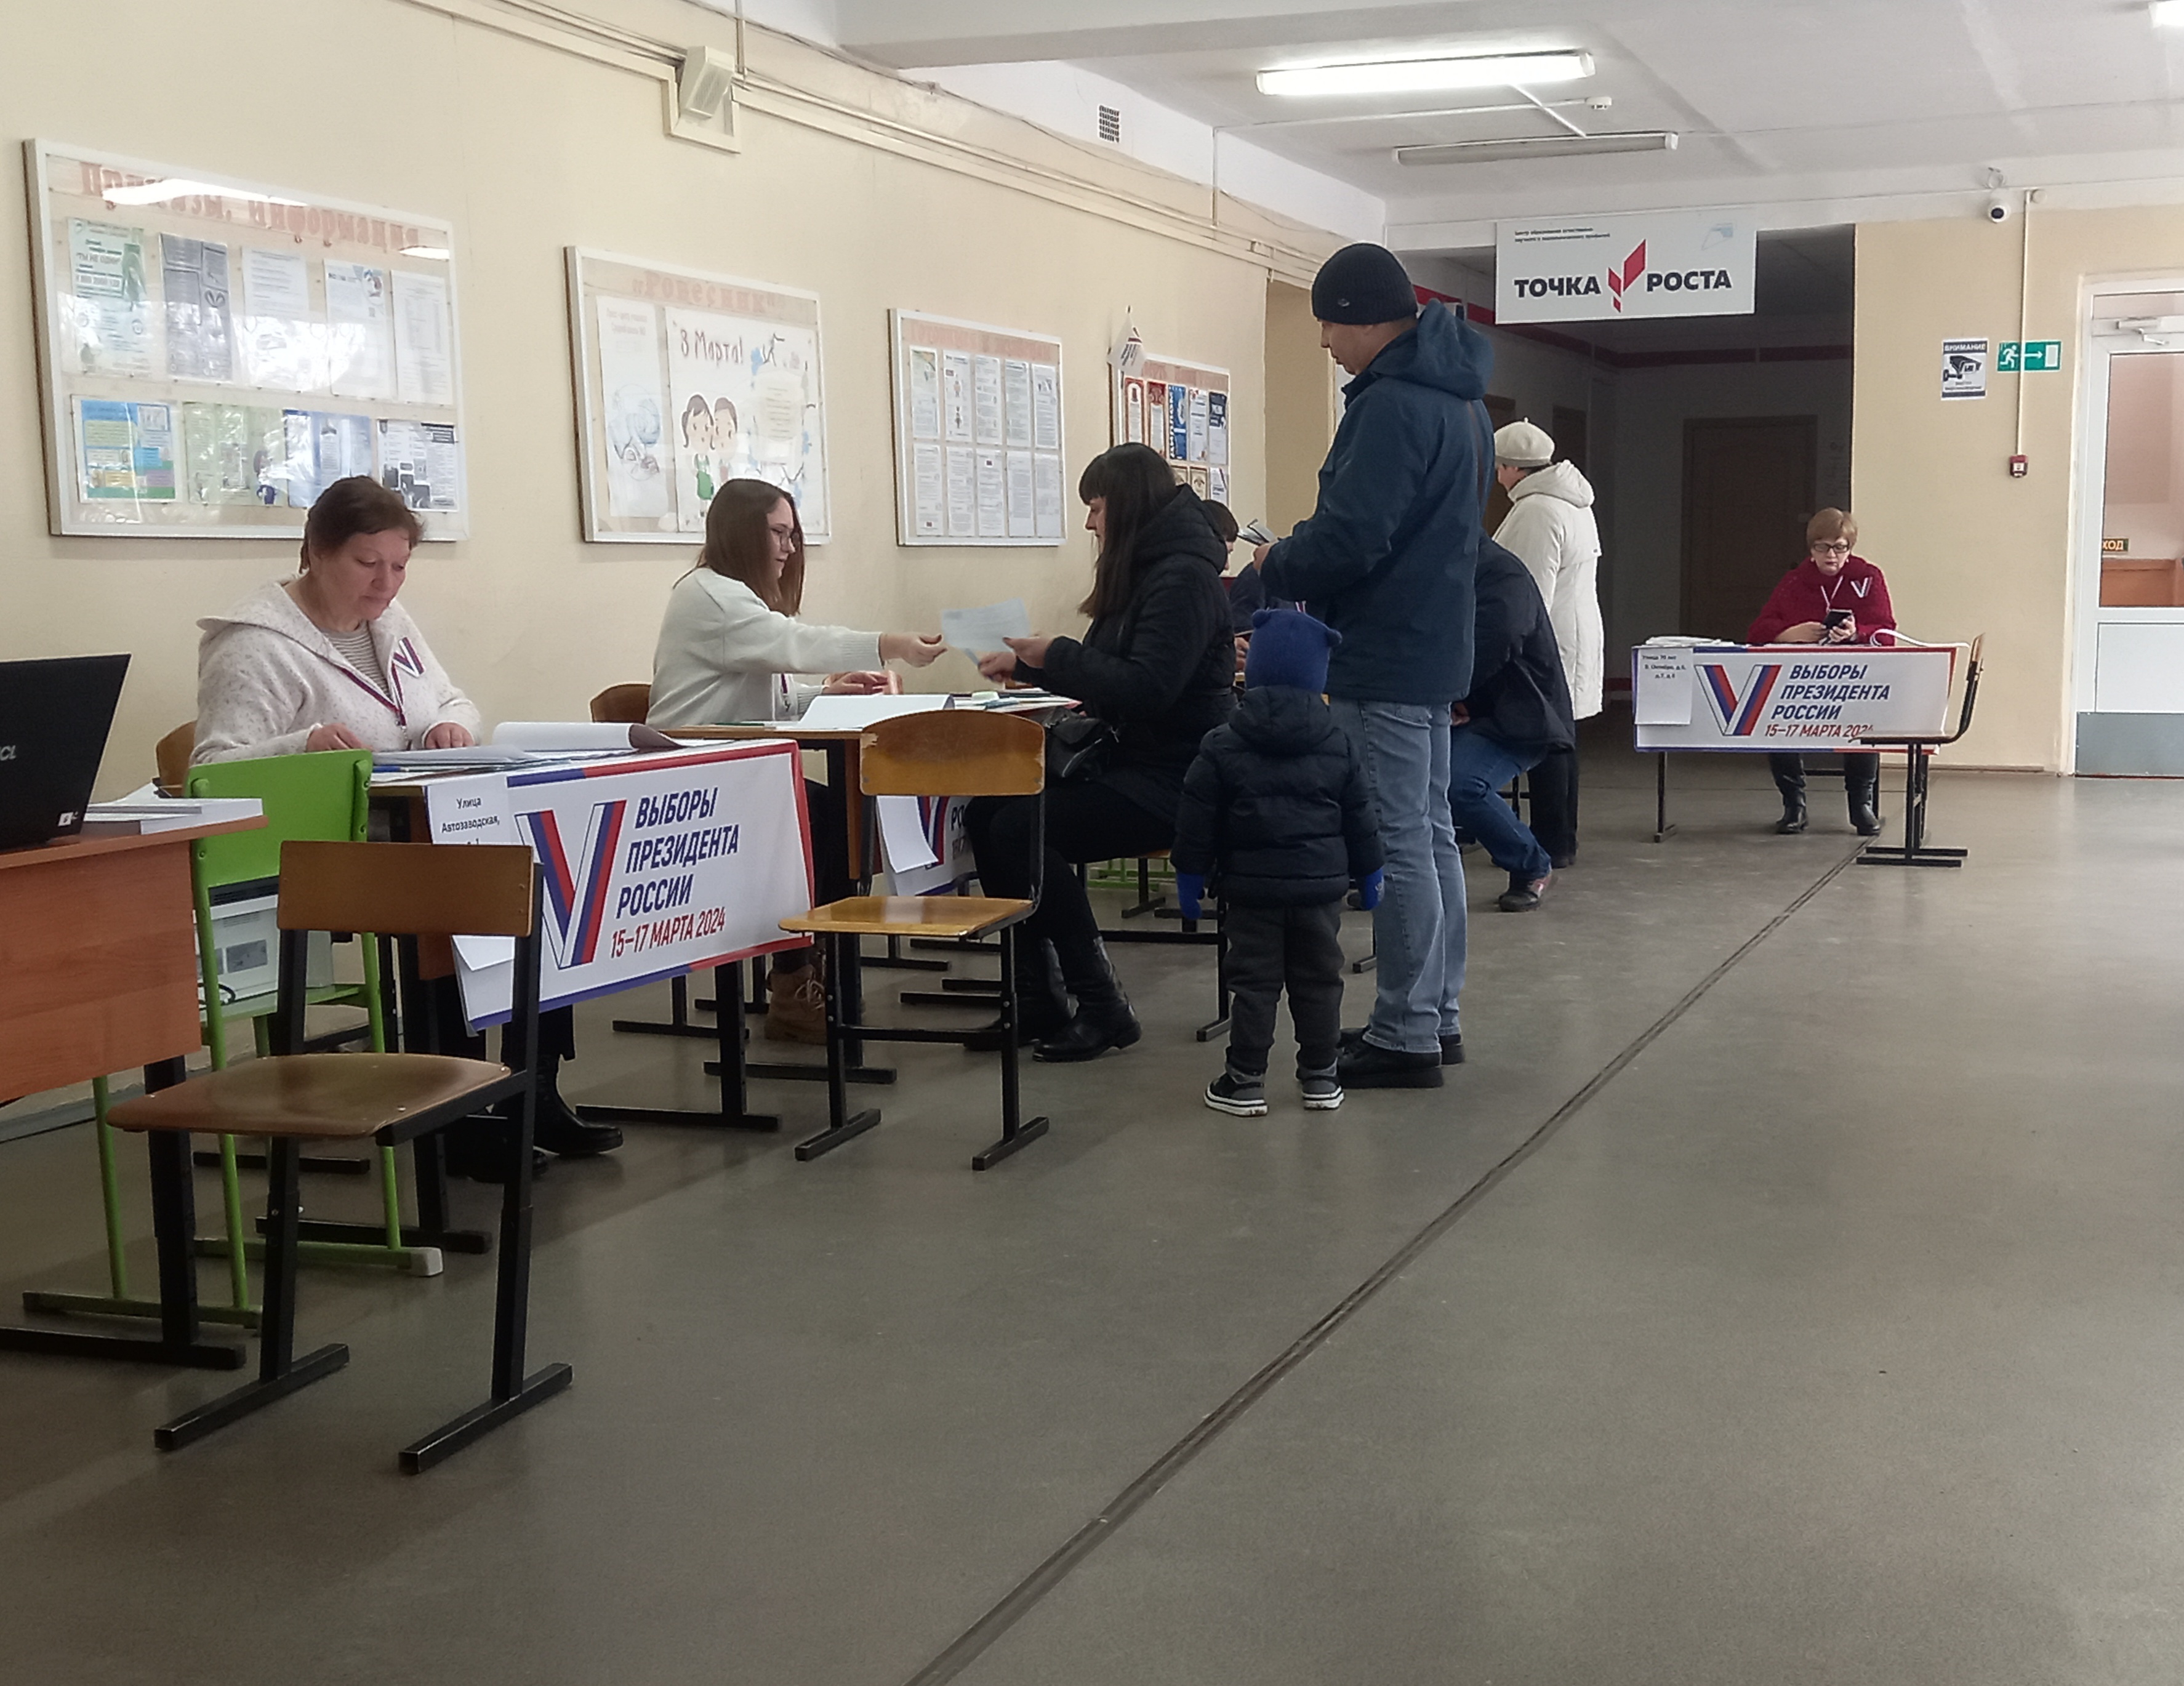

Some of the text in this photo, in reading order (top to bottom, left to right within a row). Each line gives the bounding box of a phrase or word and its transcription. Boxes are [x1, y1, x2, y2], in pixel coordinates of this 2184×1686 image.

[1514, 271, 1732, 298] ТОЧКА РОСТА
[681, 329, 743, 367] 8 Марта!
[1789, 665, 1868, 680] ВЫБОРЫ
[1780, 684, 1890, 702] ПРЕЗИДЕНТА
[1771, 705, 1842, 720] РОССИИ
[1799, 725, 1842, 737] МАРТА
[0, 745, 16, 761] CL
[456, 798, 481, 809] Улица
[635, 787, 718, 829] ВЫБОРЫ
[441, 816, 500, 833] Автозаводская,
[625, 824, 739, 874] ПРЕЗИДЕНТА
[616, 873, 694, 919] РОССИИ
[651, 915, 695, 947] МАРТА
[696, 906, 725, 936] 2024
